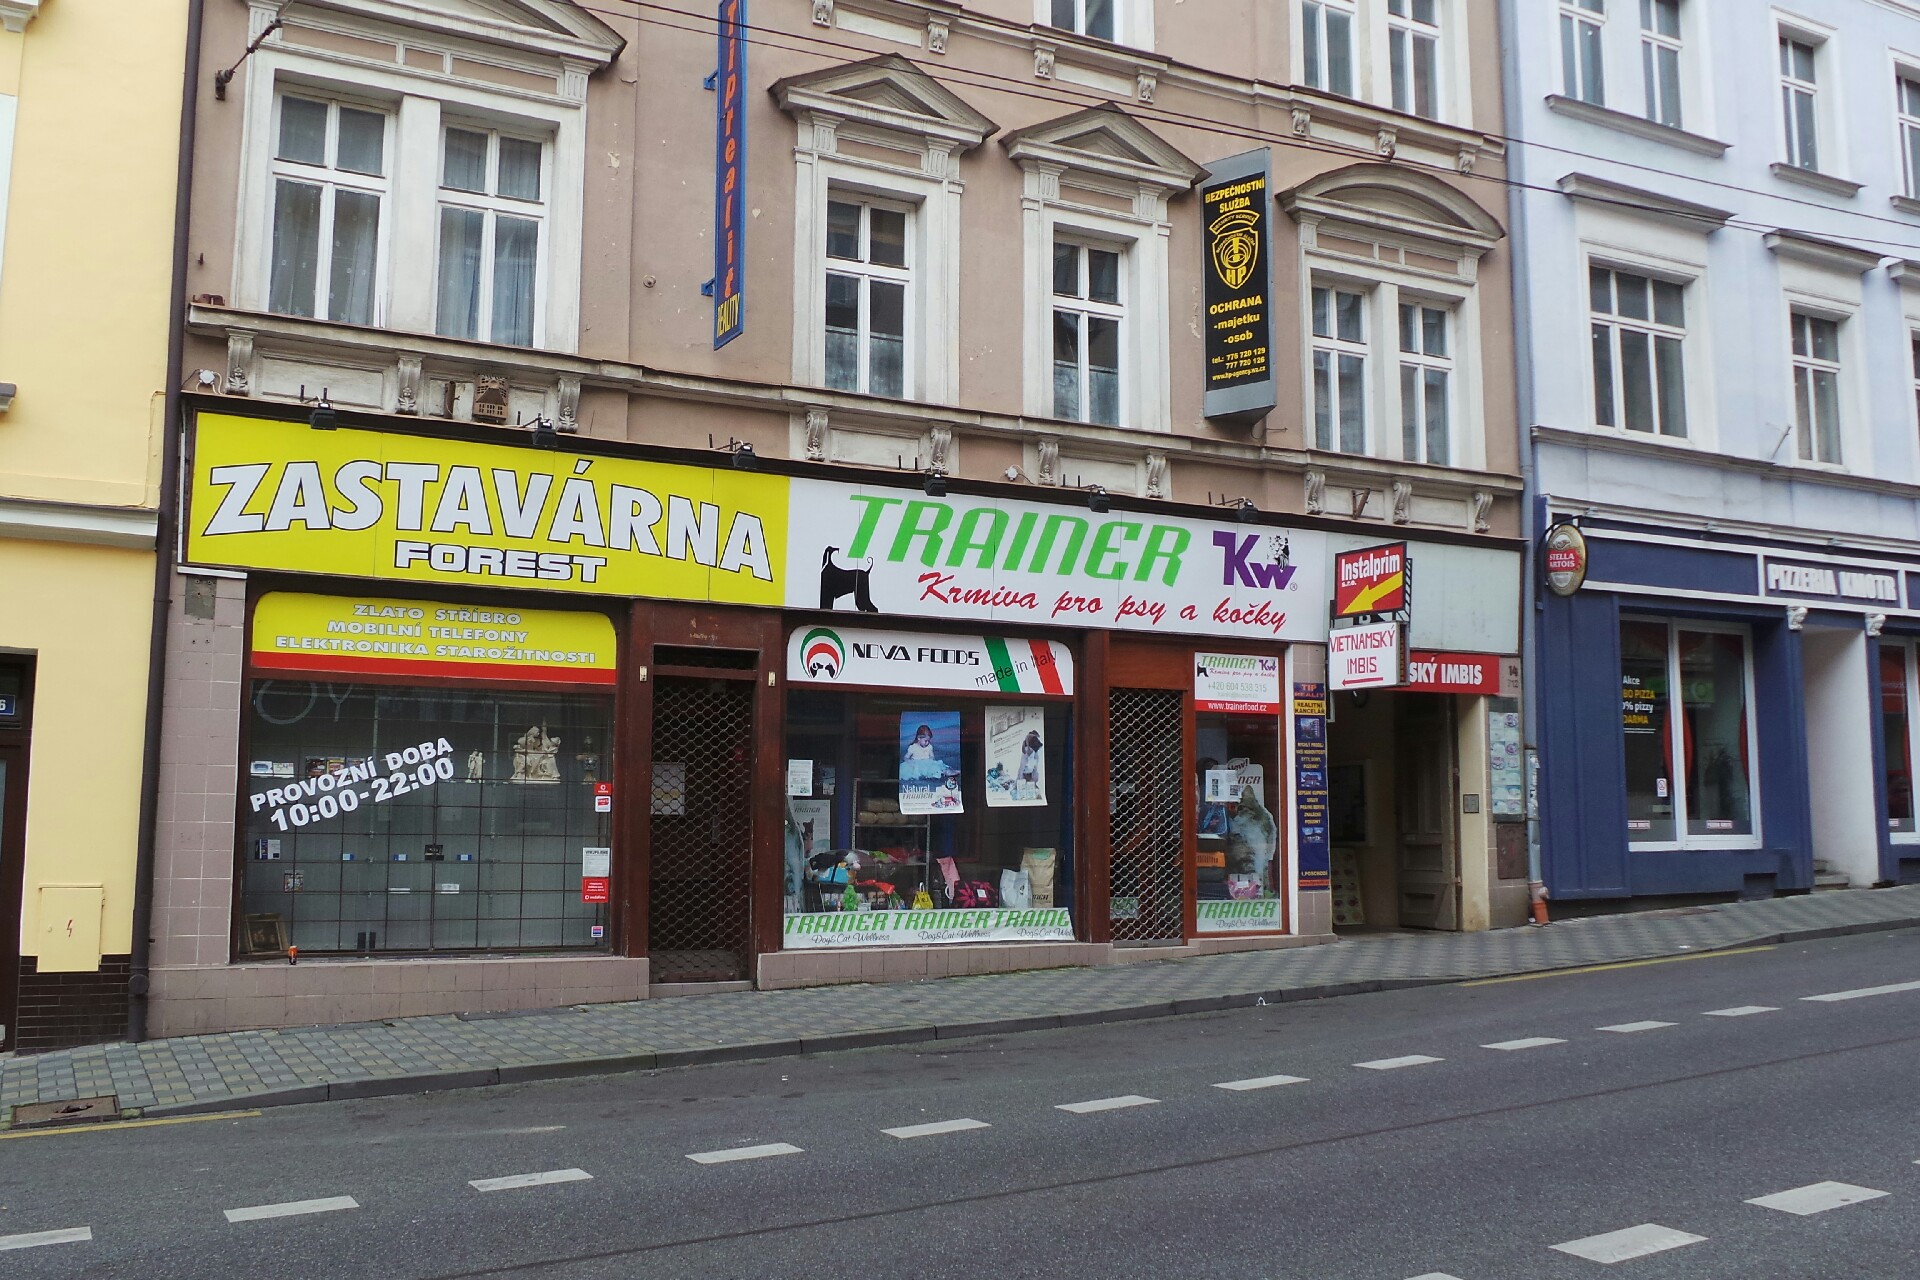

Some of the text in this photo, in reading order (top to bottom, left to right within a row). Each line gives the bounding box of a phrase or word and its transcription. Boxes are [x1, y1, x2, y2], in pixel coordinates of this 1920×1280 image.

[1205, 176, 1265, 203] BEZPEČNOSTNÍ
[1219, 196, 1250, 213] SLUŽBA
[1226, 265, 1247, 285] HP
[1209, 295, 1262, 315] OCHRANA
[1214, 313, 1260, 329] -majetku
[1224, 330, 1253, 344] -osob
[1240, 349, 1252, 358] 720
[1253, 347, 1266, 355] 129
[1225, 361, 1238, 369] 777
[1240, 358, 1251, 367] 720
[202, 460, 773, 582] ZASTAVÁRNA
[849, 494, 1192, 588] TRAINER
[394, 540, 607, 583] FOREST
[1341, 549, 1400, 581] Instalprim
[918, 572, 1287, 634] Krmiva pro psy a kočky
[353, 604, 522, 625] ZLATO STŘÍBRO
[327, 621, 528, 643] MOBILNÍ TELEFONY
[1329, 624, 1395, 653] VIETNAMSKÝ
[275, 636, 596, 663] ELEKTRONIKA STAROŽITNOSTI
[852, 643, 979, 666] NOVA FOODS
[975, 650, 1057, 688] made in Italy
[1202, 656, 1257, 670] TRAINER
[1346, 656, 1377, 675] IMBIS
[1441, 663, 1483, 685] IMBIS
[1623, 675, 1640, 685] Akce
[1208, 682, 1225, 690] +420
[1226, 682, 1239, 691] 604
[1255, 684, 1267, 692] 315
[1634, 689, 1655, 699] PIZZA
[1208, 702, 1267, 712] www.trainerfood.cz
[1634, 701, 1653, 713] pizzy
[250, 737, 454, 812] PROVOZNÍ DOBA
[903, 784, 930, 793] Natural
[1197, 902, 1277, 919] TRAINER
[785, 912, 889, 934] TRAINER
[893, 910, 991, 930] TRAINER
